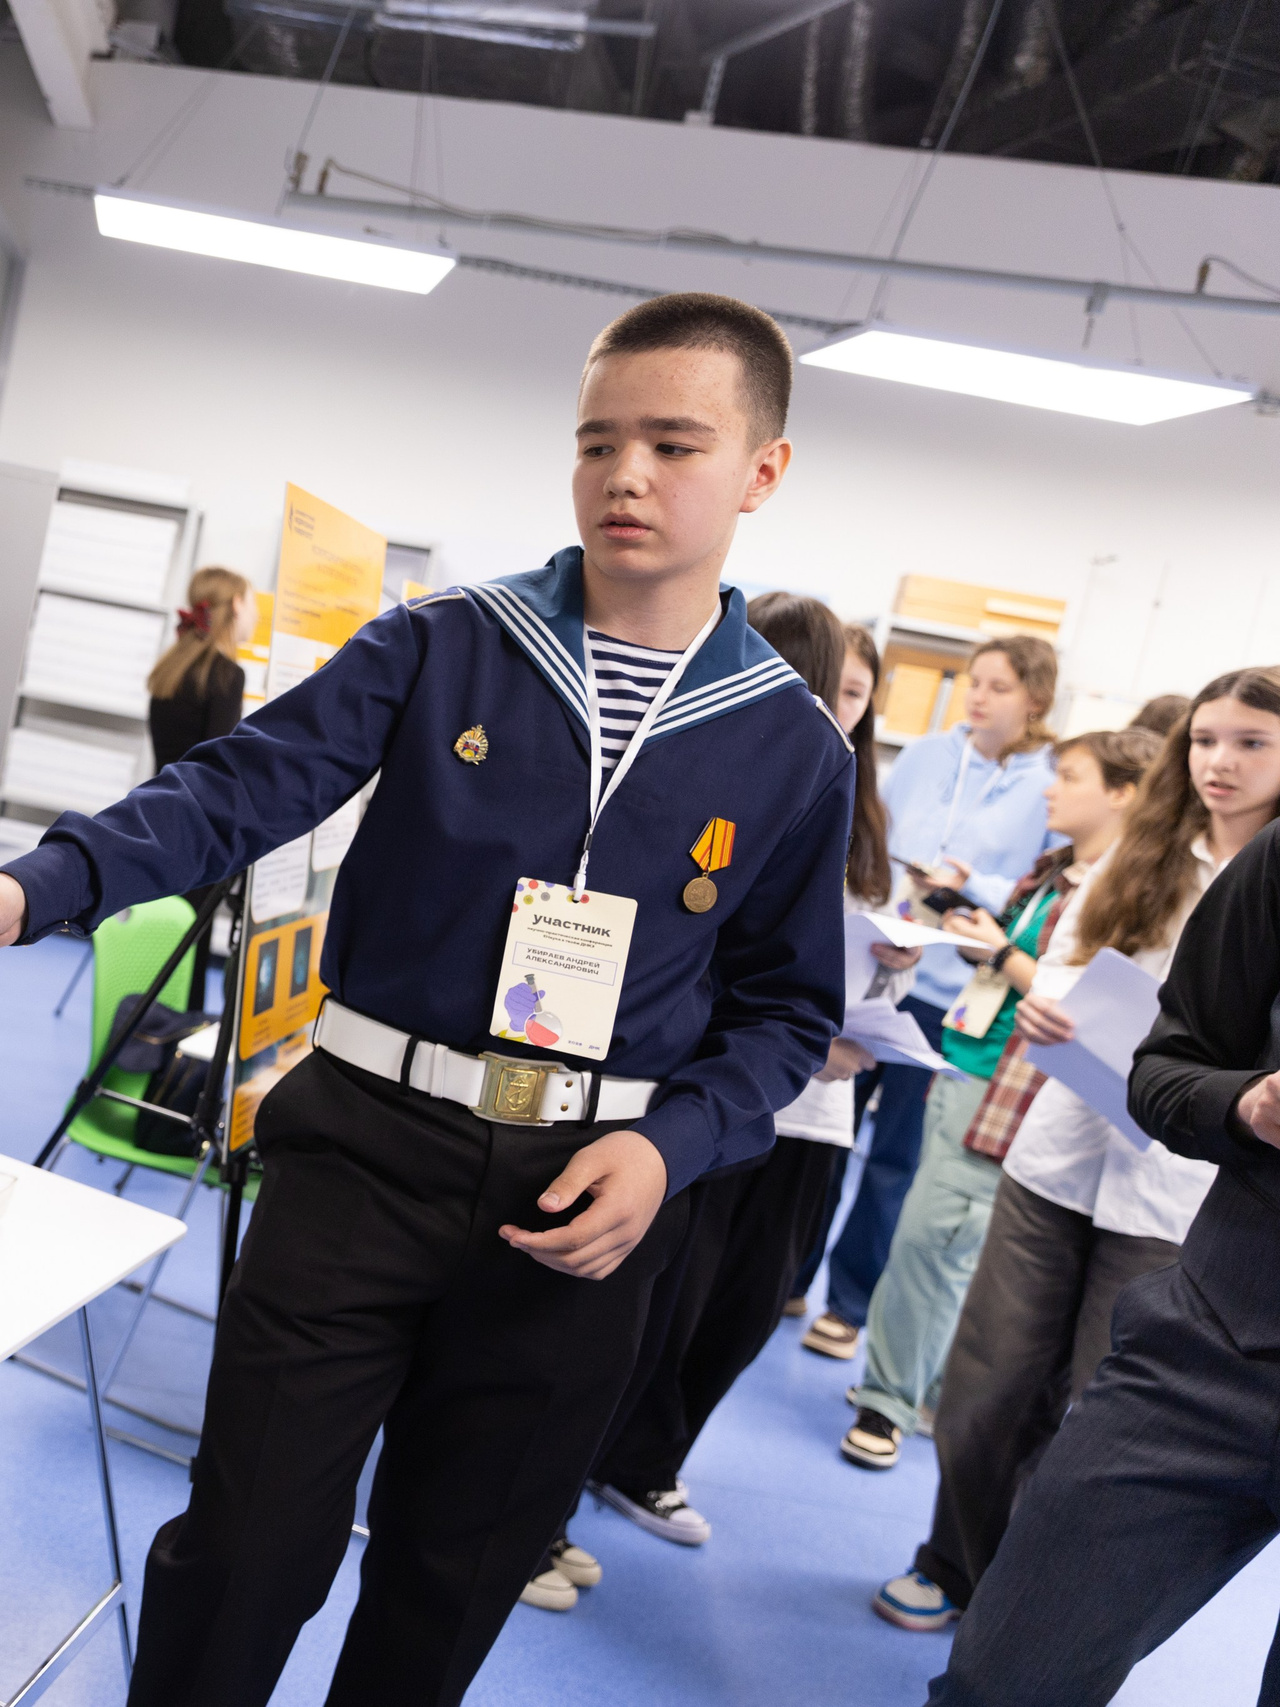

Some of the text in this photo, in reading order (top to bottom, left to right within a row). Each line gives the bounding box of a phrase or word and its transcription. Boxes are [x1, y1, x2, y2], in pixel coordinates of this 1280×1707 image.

[532, 913, 611, 937] участник
[525, 955, 599, 975] АЛЕКСАНДРОВИЧ
[527, 947, 601, 969] УБИРАЕВ АНДРЕЙ
